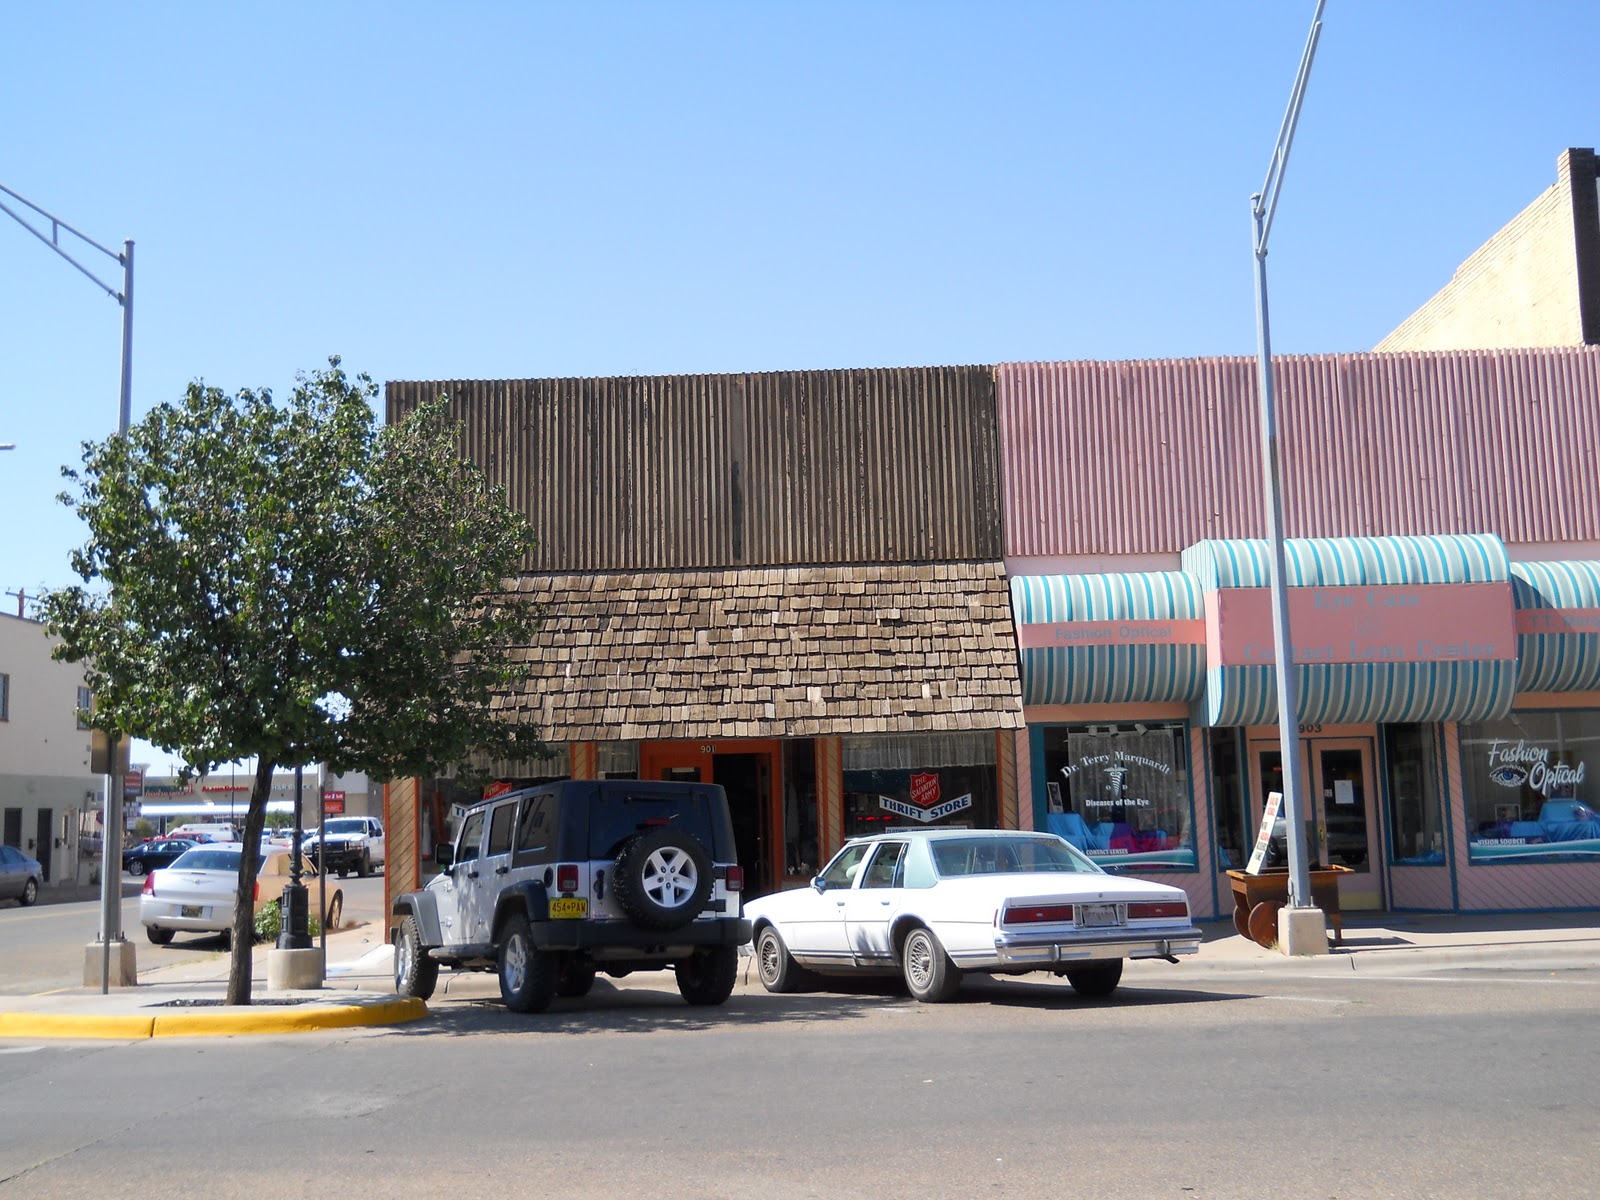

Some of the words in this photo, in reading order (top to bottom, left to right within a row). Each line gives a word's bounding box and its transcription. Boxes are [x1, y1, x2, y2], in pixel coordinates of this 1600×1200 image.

[1314, 591, 1356, 612] Eye
[1367, 590, 1421, 608] Care
[1055, 627, 1112, 640] Fashion
[1119, 625, 1172, 639] Optical
[1244, 642, 1334, 661] Cotact
[1351, 641, 1406, 659] Lens
[1417, 639, 1496, 658] Center
[1298, 724, 1321, 733] 903
[701, 745, 715, 753] 901
[1487, 738, 1549, 767] Fashion
[1060, 763, 1080, 779] Dr.
[1080, 754, 1111, 767] Terry
[1114, 751, 1171, 774] Marquardt
[911, 777, 937, 799] SALVATION
[915, 776, 927, 787] THE
[1529, 761, 1585, 797] Optical
[921, 786, 937, 803] ARMY
[1085, 799, 1114, 807] Diseases
[1136, 798, 1150, 806] Eye
[882, 798, 923, 819] THRIFT
[930, 796, 968, 818] STORE
